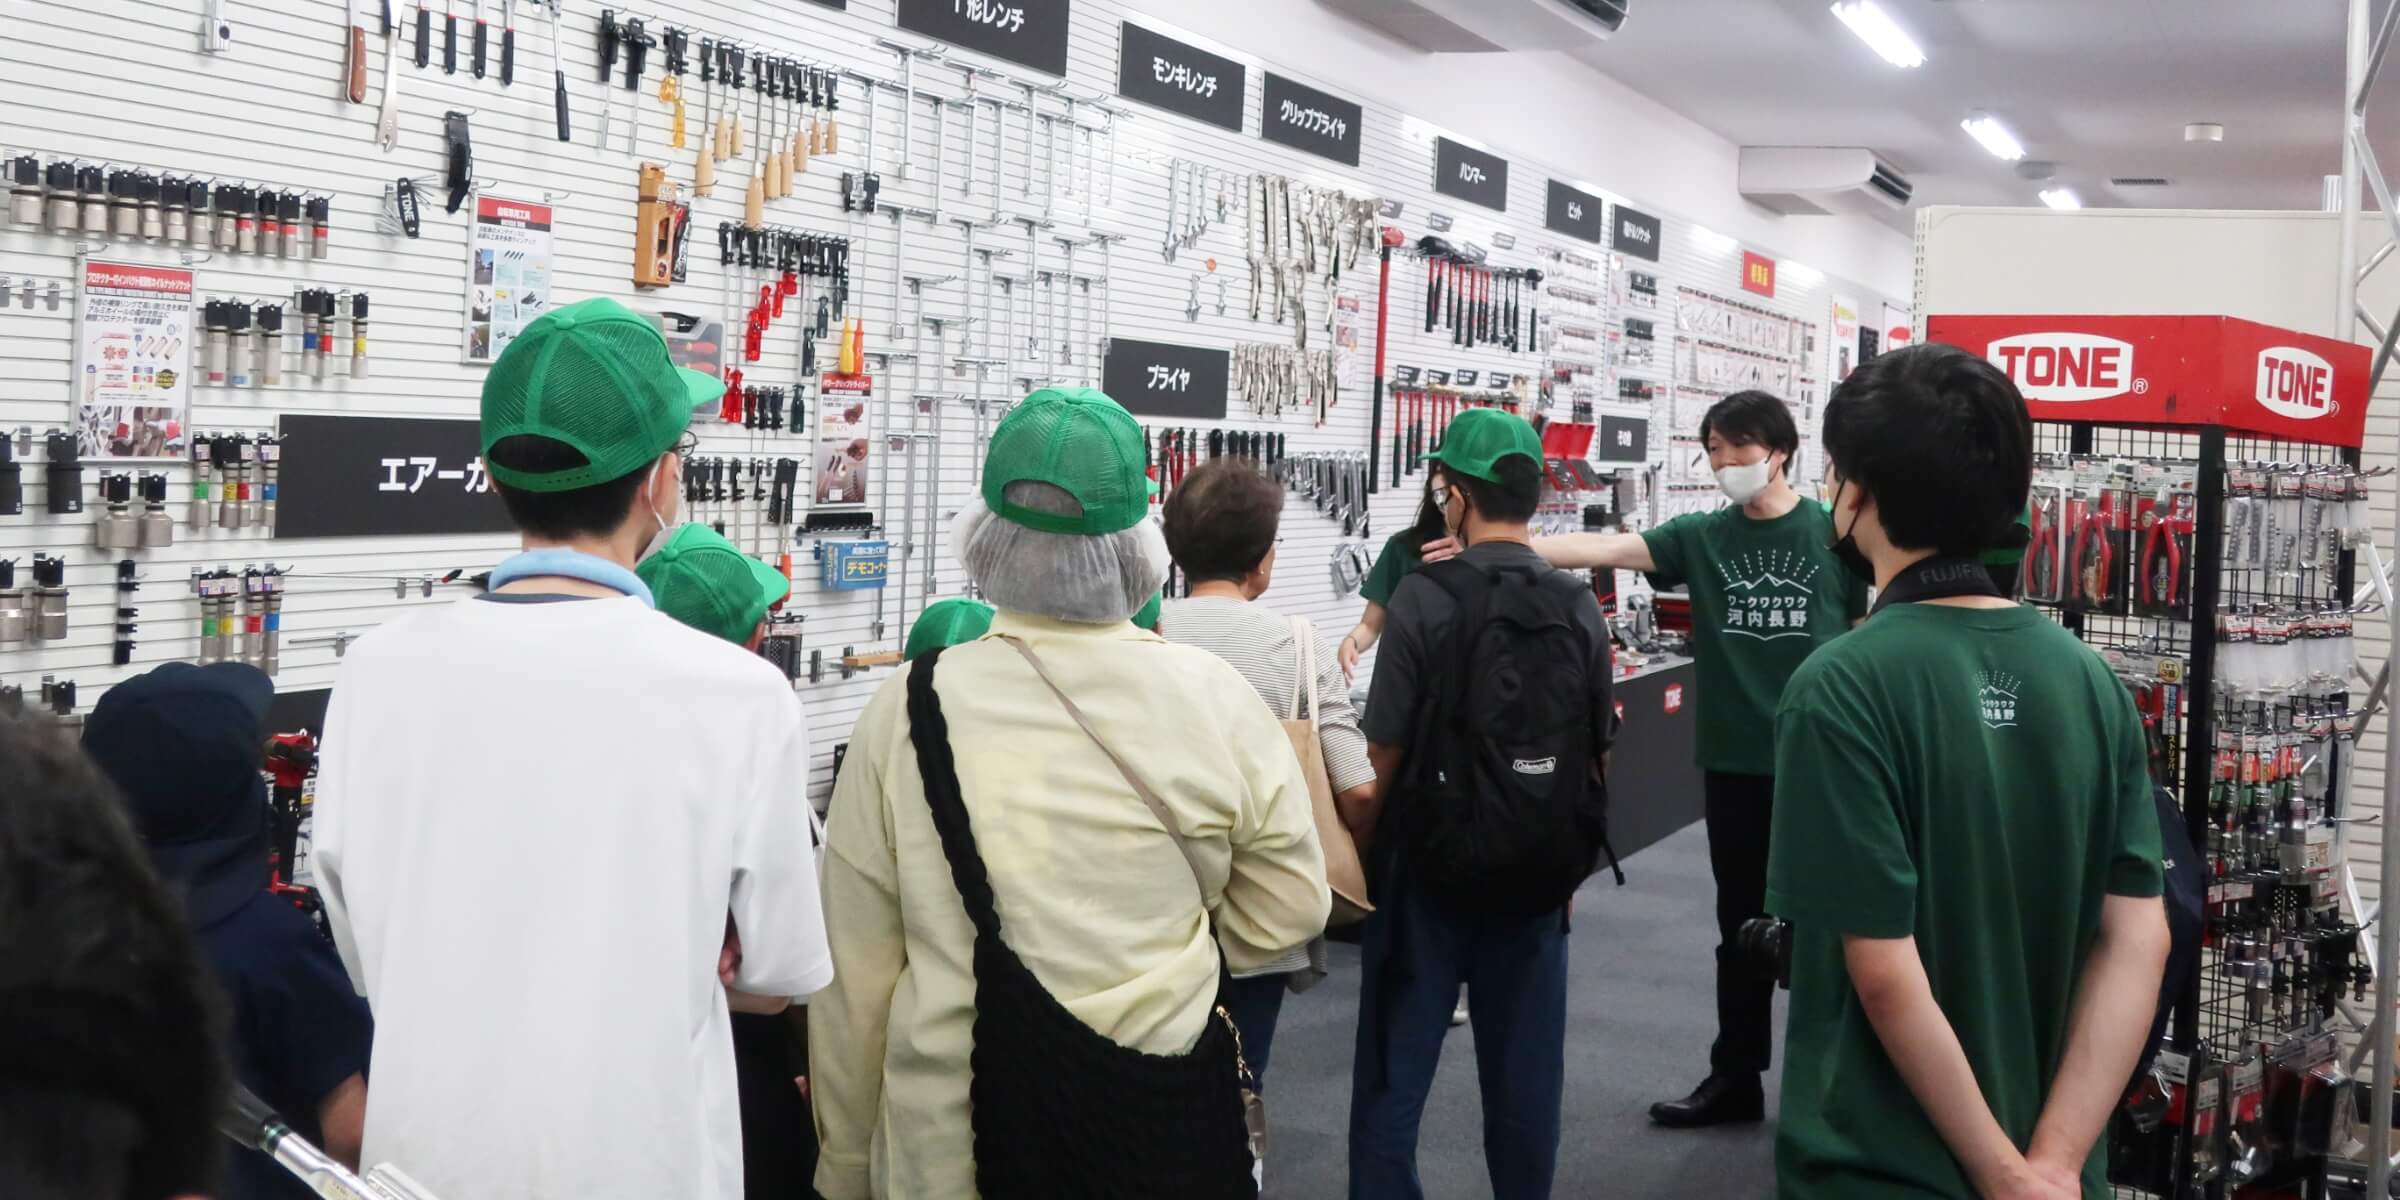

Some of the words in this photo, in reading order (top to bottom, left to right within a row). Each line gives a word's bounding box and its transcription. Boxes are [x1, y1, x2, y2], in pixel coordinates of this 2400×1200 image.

[1152, 56, 1217, 98] モンキレンチ
[1280, 98, 1346, 141] グリッププライヤ
[1459, 161, 1487, 185] ハンマー
[401, 192, 416, 223] TONE
[1147, 364, 1191, 392] プライヤ
[1998, 346, 2121, 388] TONE
[2264, 356, 2327, 408] TONE
[1727, 595, 1807, 609] ワークワクワク
[1727, 608, 1807, 627] 河内長野
